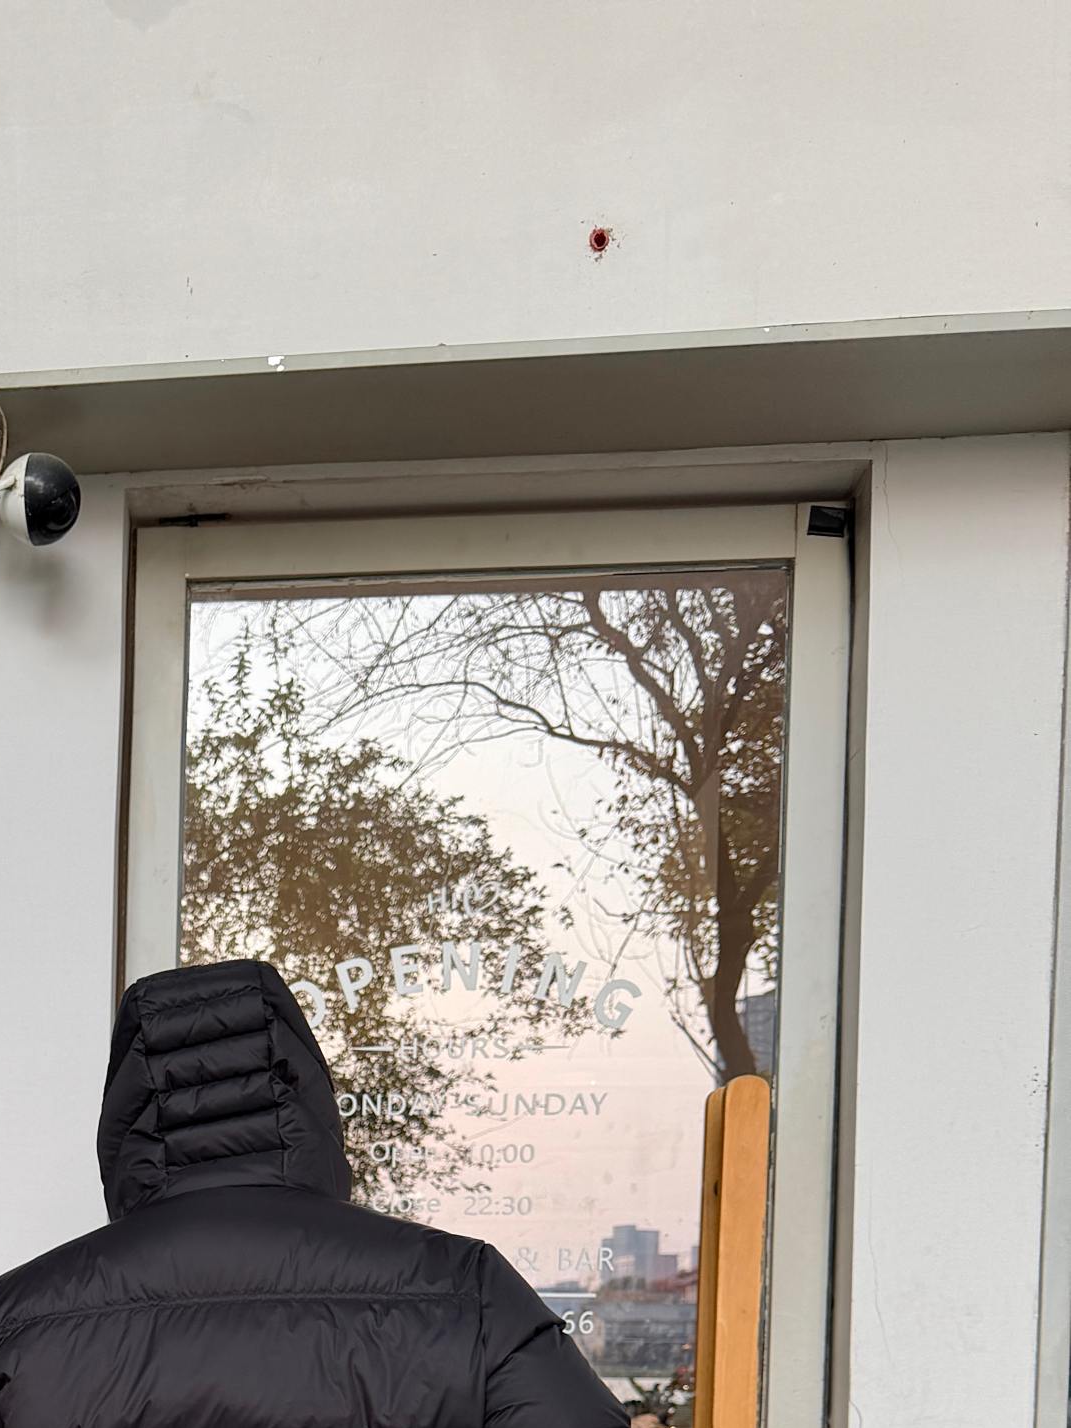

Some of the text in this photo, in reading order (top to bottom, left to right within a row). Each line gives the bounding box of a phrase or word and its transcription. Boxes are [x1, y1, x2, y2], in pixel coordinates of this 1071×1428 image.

[289, 941, 643, 1029] OPENING
[400, 1036, 510, 1059] HOURS
[372, 1193, 532, 1215] Close 22:30
[558, 1246, 615, 1272] BAR
